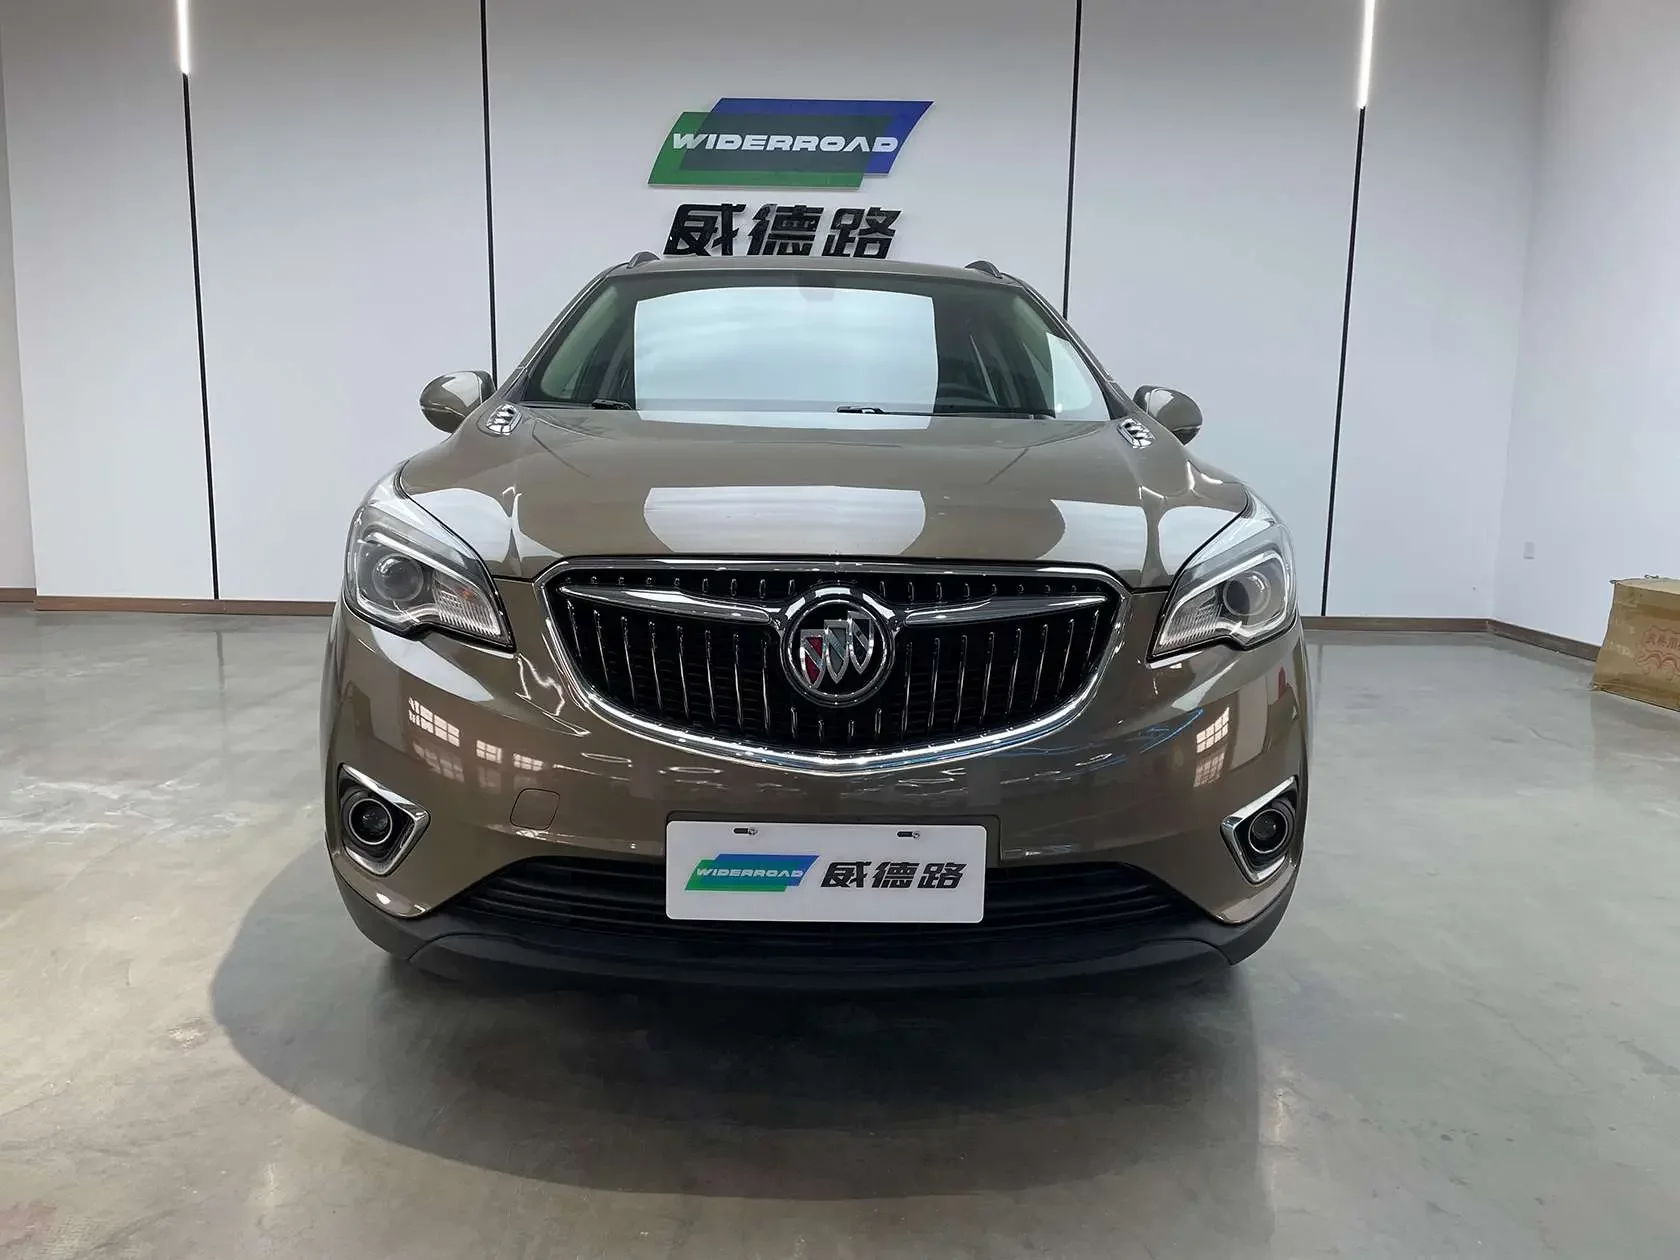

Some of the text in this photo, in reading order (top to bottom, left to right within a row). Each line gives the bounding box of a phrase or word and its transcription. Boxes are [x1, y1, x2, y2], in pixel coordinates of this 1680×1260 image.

[672, 133, 899, 153] WIDERROAD
[663, 203, 903, 260] 威德路
[695, 867, 805, 878] WIDERROAD
[820, 861, 967, 889] 威德路
